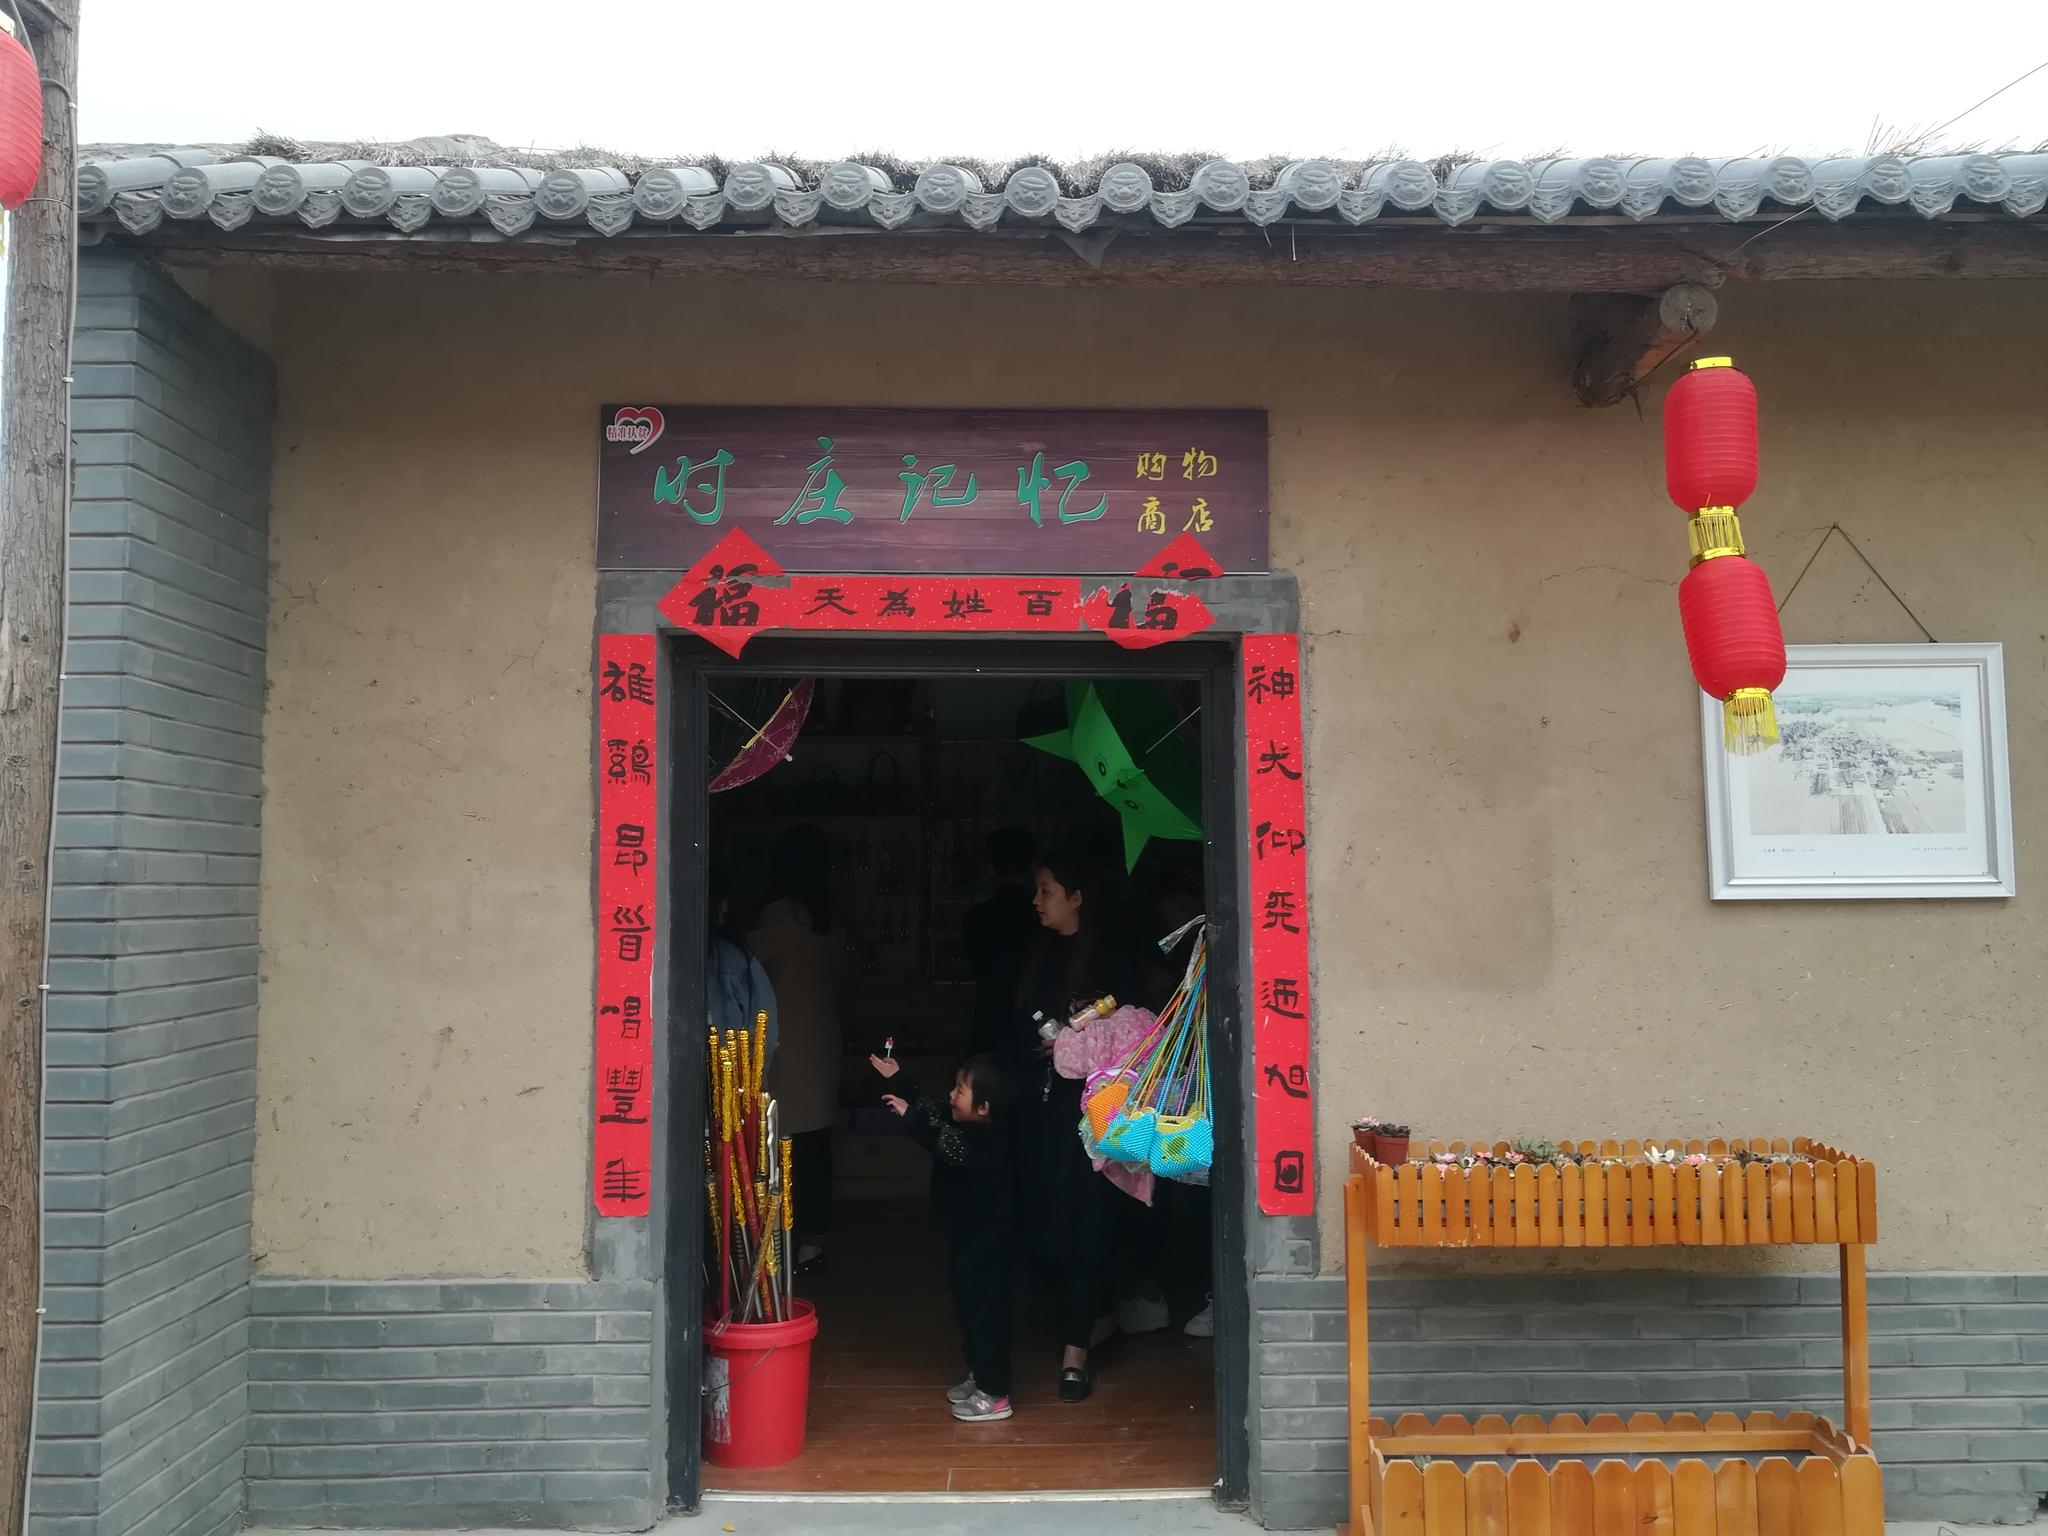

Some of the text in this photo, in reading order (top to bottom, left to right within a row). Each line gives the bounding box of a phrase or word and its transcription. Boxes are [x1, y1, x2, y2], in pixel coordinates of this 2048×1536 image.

[653, 436, 1109, 527] 时庄记忆
[1136, 447, 1218, 481] 购物
[1137, 496, 1214, 535] 商店
